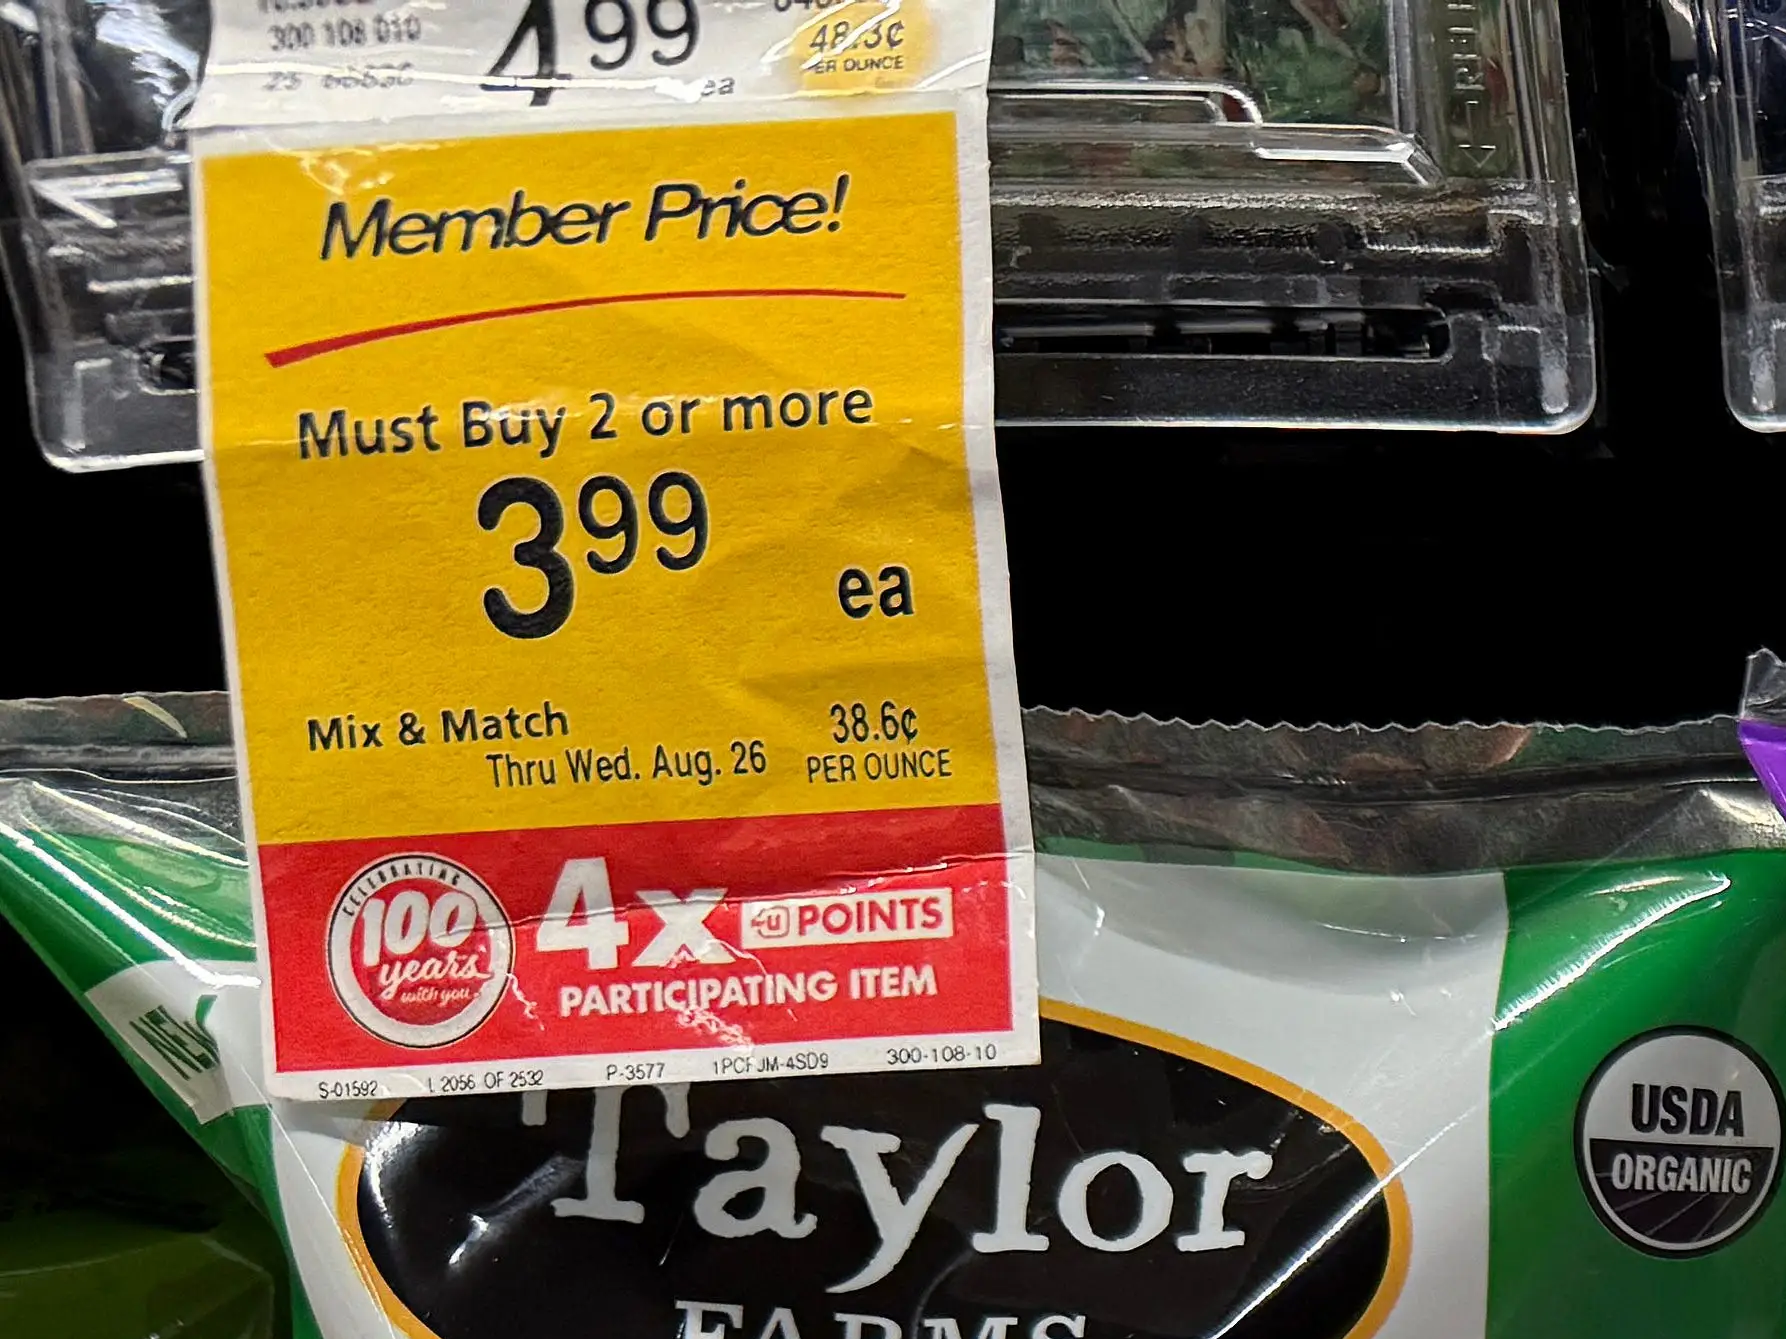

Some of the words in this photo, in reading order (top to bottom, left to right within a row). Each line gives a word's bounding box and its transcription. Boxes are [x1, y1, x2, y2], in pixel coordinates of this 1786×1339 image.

[320, 191, 630, 260] Member
[646, 176, 851, 243] Price!
[298, 412, 440, 460] Must
[465, 406, 564, 458] Buy
[591, 395, 618, 436] 2
[643, 400, 698, 437] or
[724, 387, 872, 431] more
[838, 565, 914, 619] ea
[829, 702, 917, 744] 38.6¢
[487, 754, 555, 788] Thru
[567, 751, 640, 783] Wed.
[653, 744, 722, 785] Aug.
[731, 742, 767, 774] 26
[798, 897, 944, 935] POINTS
[560, 972, 838, 1018] PARTICIPATING
[850, 967, 937, 998] ITEM
[1631, 1083, 1744, 1138] USDA
[522, 1080, 1273, 1294] Taylor
[1612, 1153, 1752, 1195] ORGANIC
